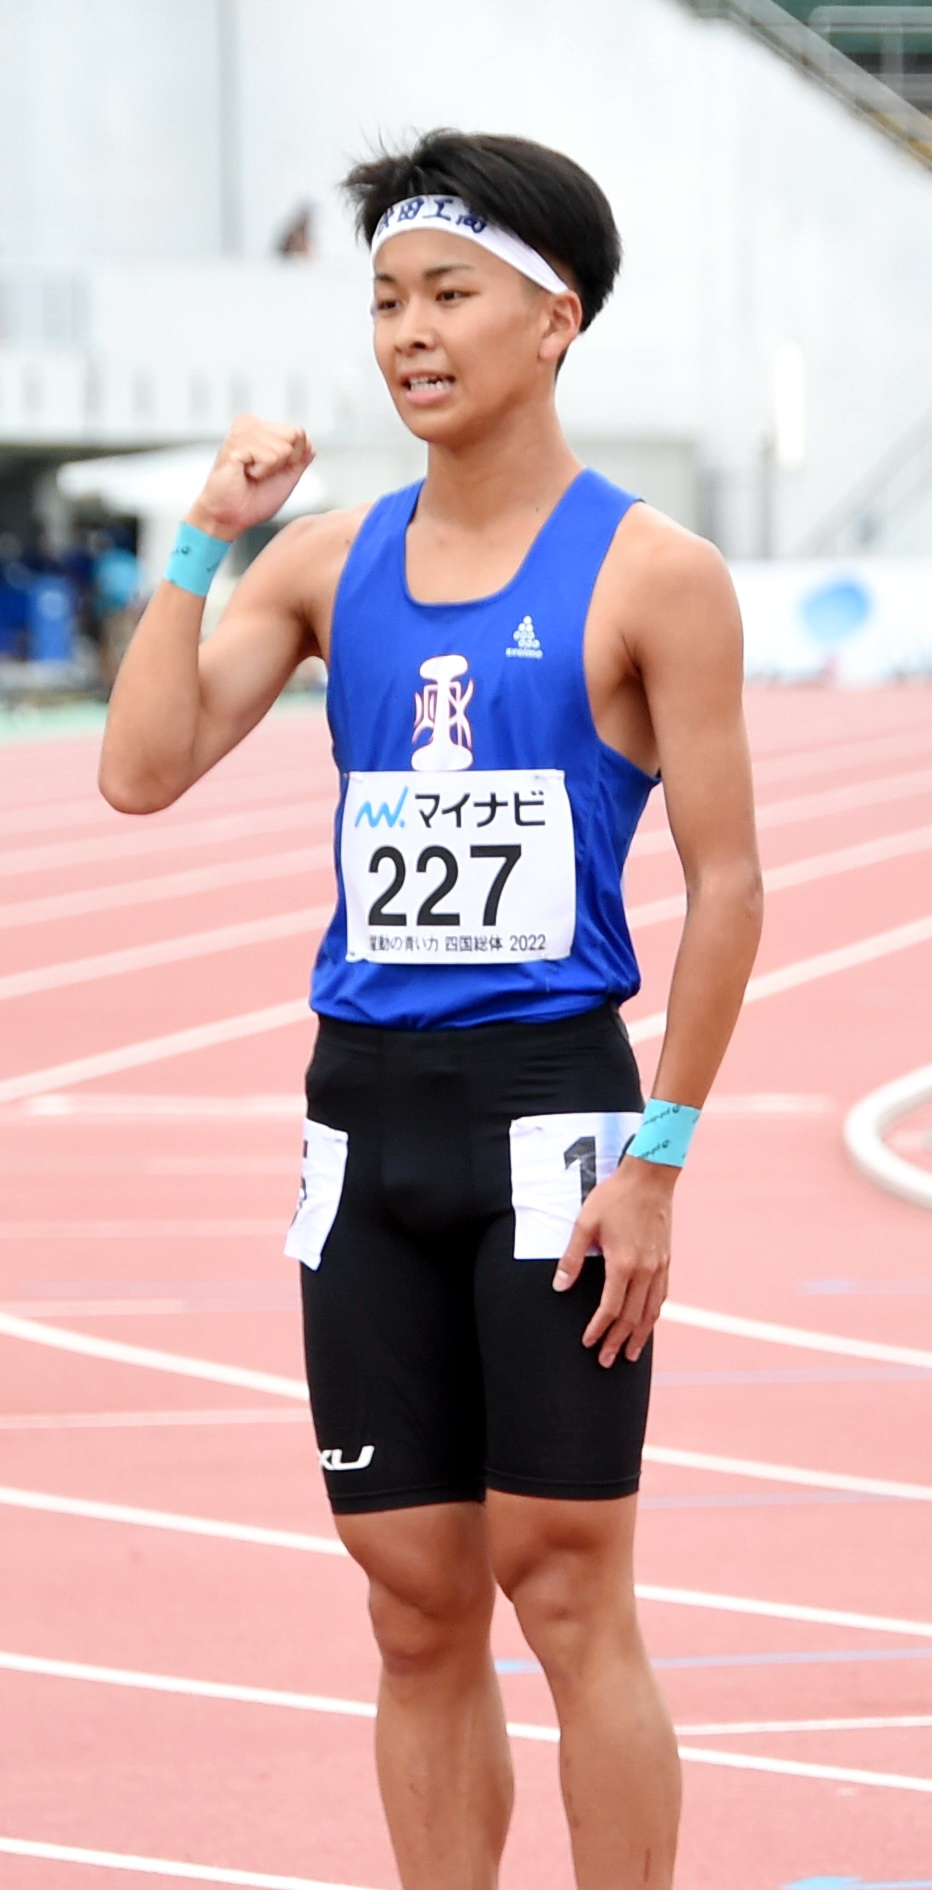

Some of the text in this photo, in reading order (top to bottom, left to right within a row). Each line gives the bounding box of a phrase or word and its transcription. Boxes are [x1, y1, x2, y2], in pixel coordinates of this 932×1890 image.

[414, 791, 546, 828] マイナビ
[368, 844, 522, 926] 227
[445, 935, 503, 952] 四国総体
[509, 933, 547, 952] 2022
[563, 1132, 637, 1206] 1
